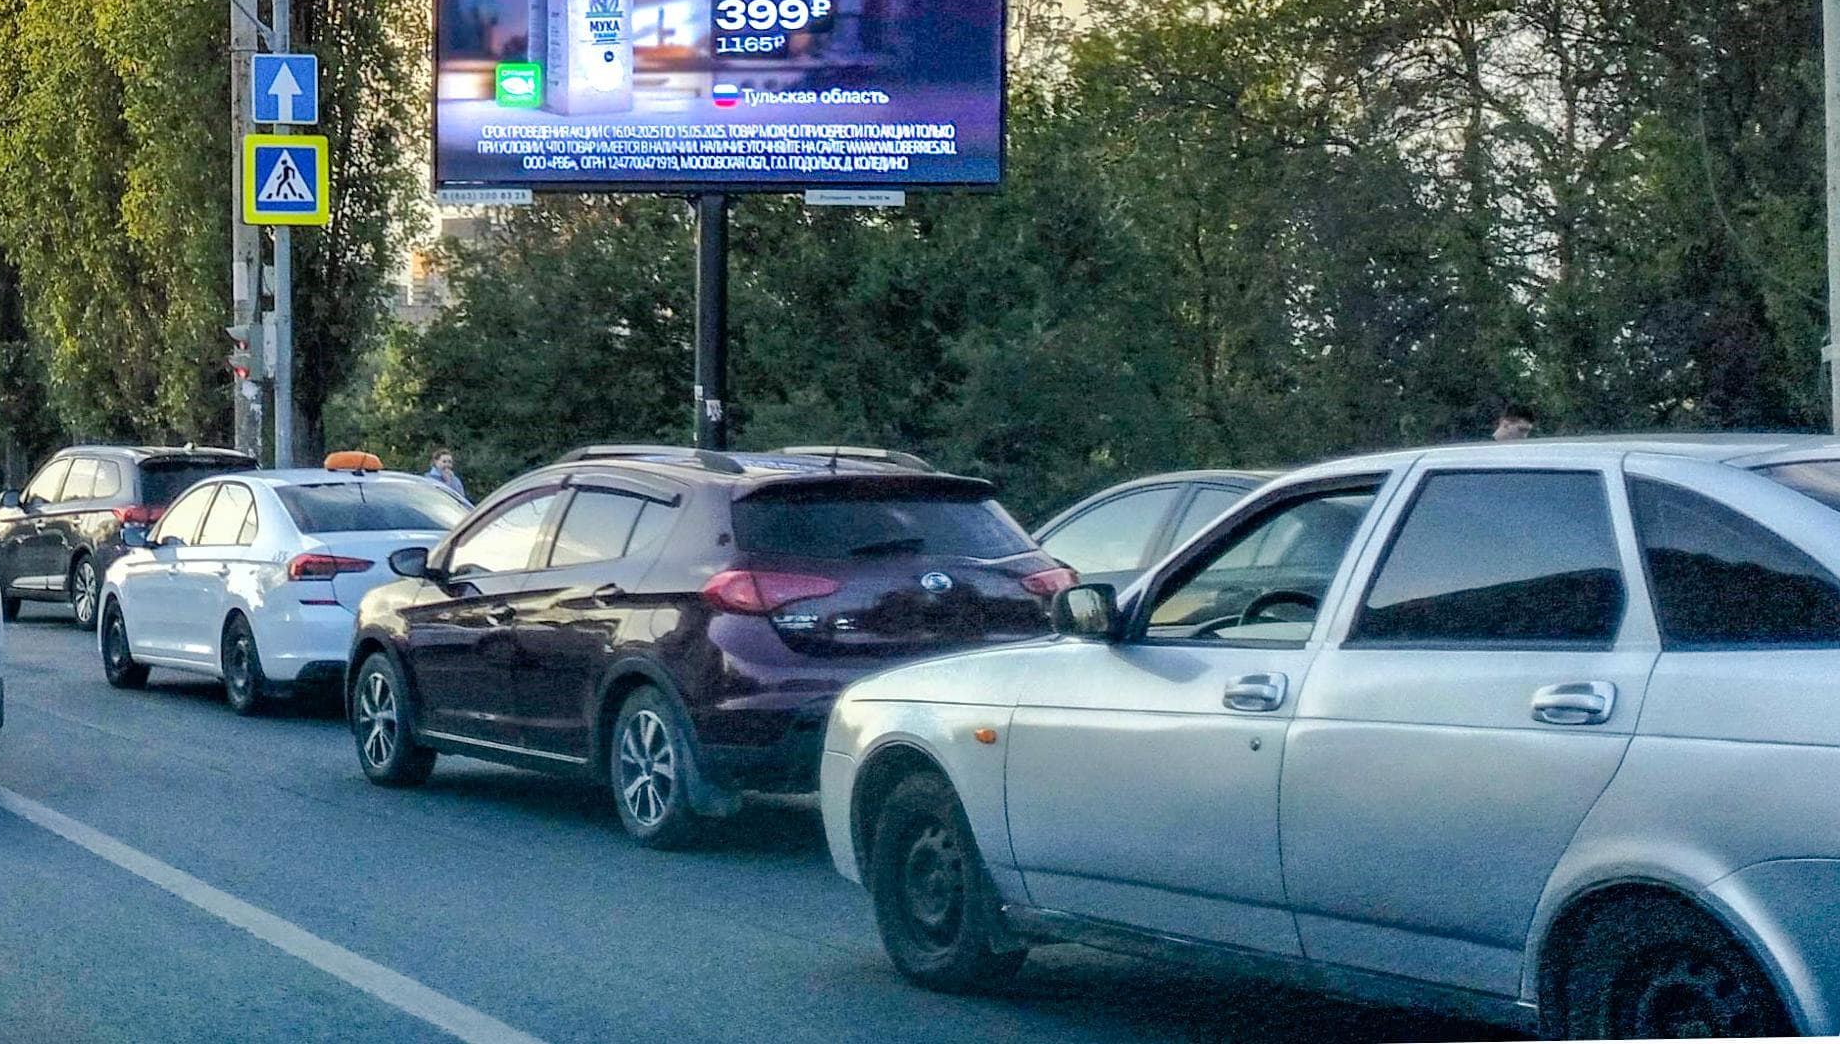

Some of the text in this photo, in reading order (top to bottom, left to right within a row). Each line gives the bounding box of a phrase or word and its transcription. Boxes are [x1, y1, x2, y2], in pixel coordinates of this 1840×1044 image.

[589, 19, 620, 33] МУКА
[741, 87, 890, 107] Тульская область
[523, 155, 546, 172] ООО
[580, 155, 606, 172] ОГРН
